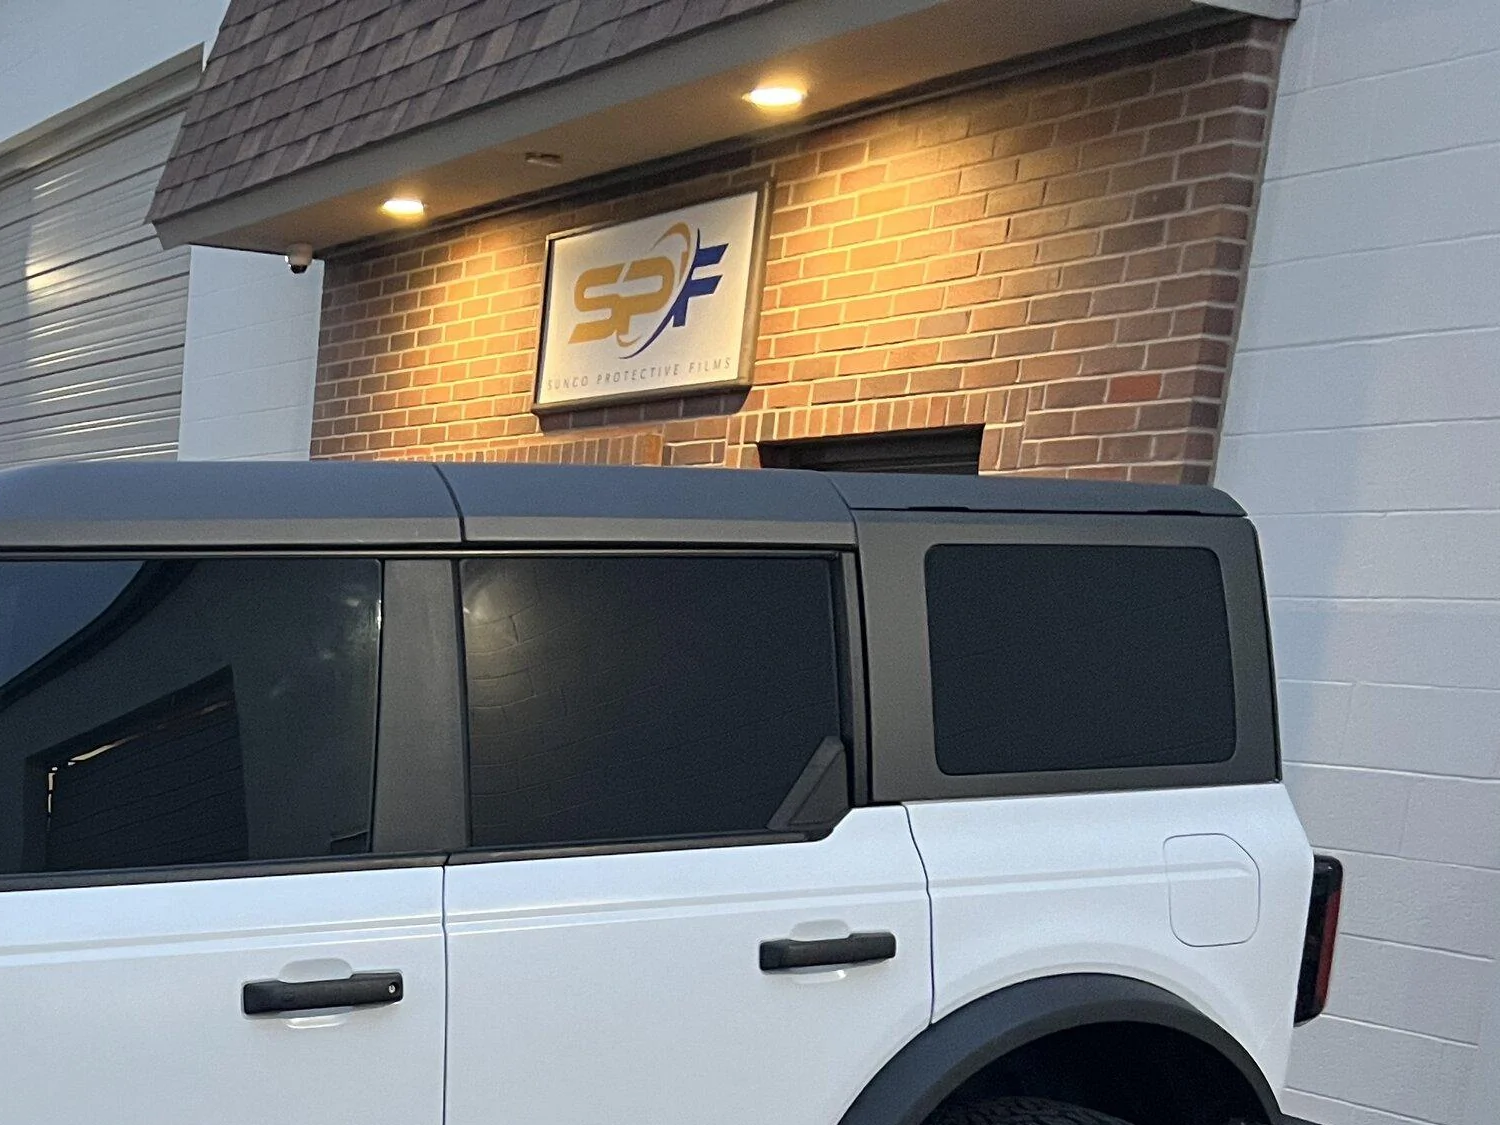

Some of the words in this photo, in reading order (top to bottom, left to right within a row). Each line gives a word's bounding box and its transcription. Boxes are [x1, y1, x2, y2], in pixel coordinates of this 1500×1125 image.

[568, 228, 729, 350] SPF
[547, 375, 589, 391] SUNCO
[596, 363, 680, 385] PROTECTIVE
[688, 356, 732, 373] FILMS
